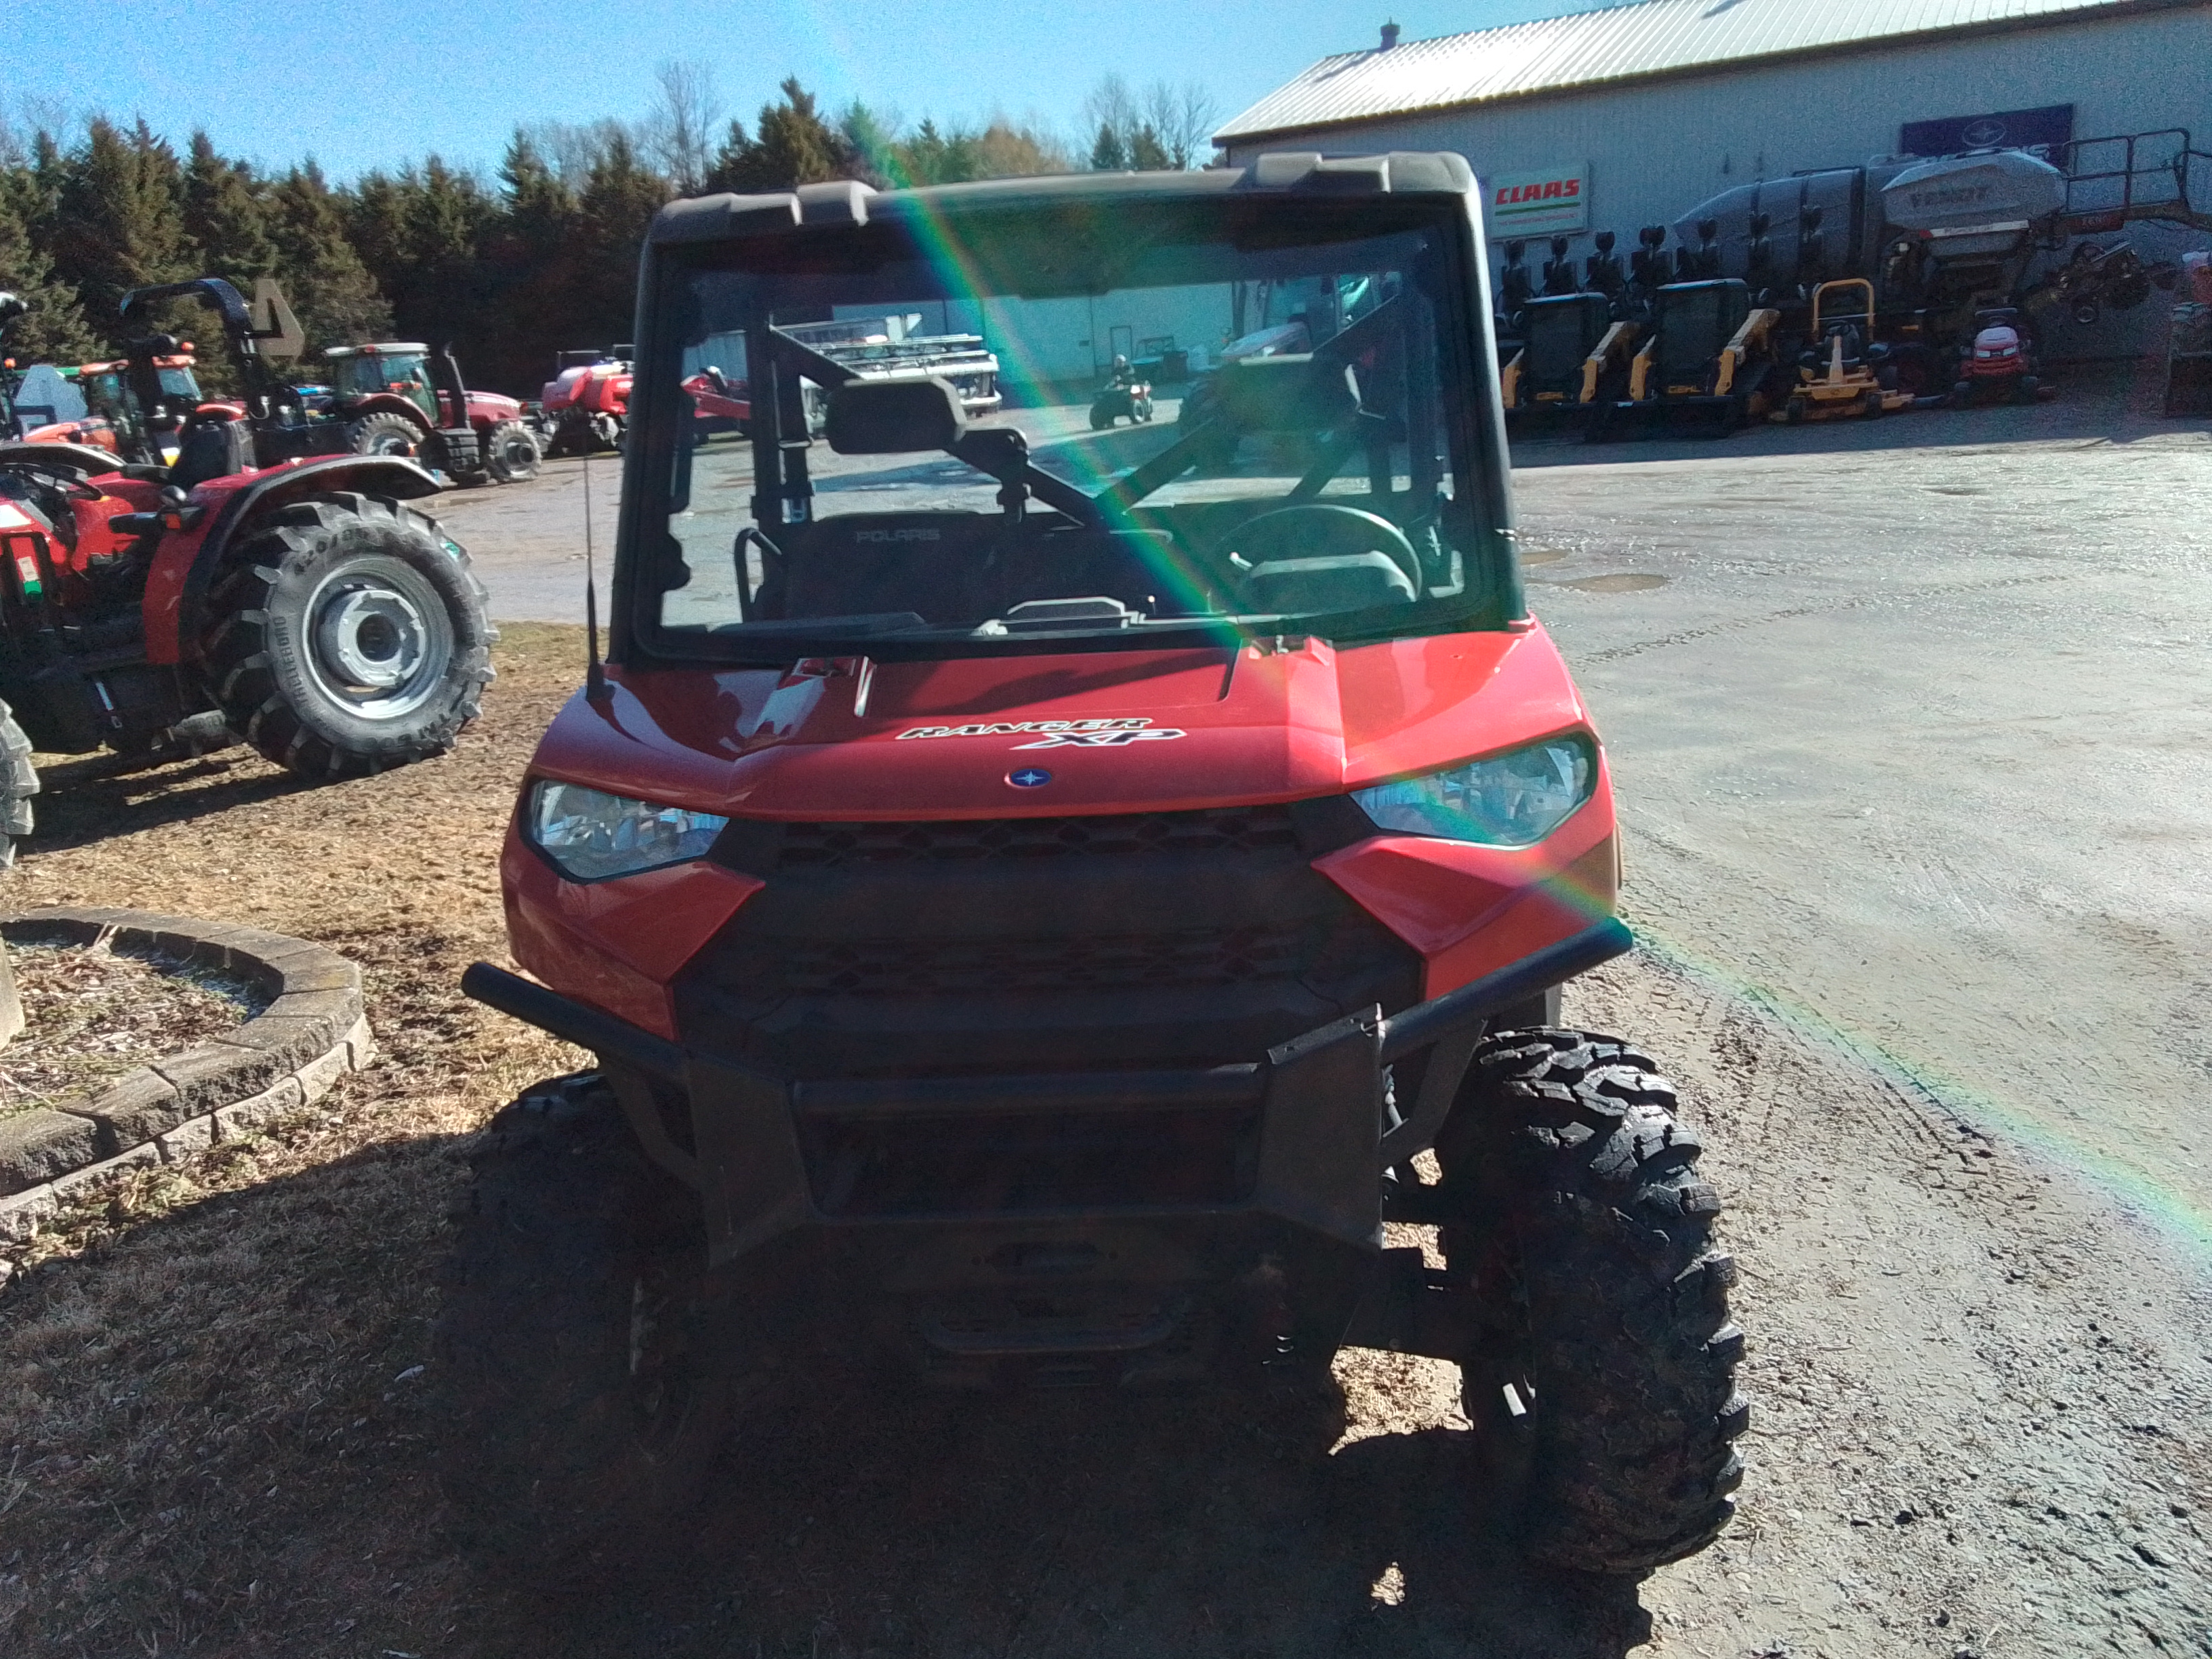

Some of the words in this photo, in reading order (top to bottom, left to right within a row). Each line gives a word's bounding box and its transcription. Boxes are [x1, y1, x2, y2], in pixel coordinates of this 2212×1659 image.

[1496, 179, 1581, 205] CLAAS
[856, 528, 941, 544] POLARIS
[895, 718, 1153, 739] RANGER
[1010, 728, 1186, 750] XP
